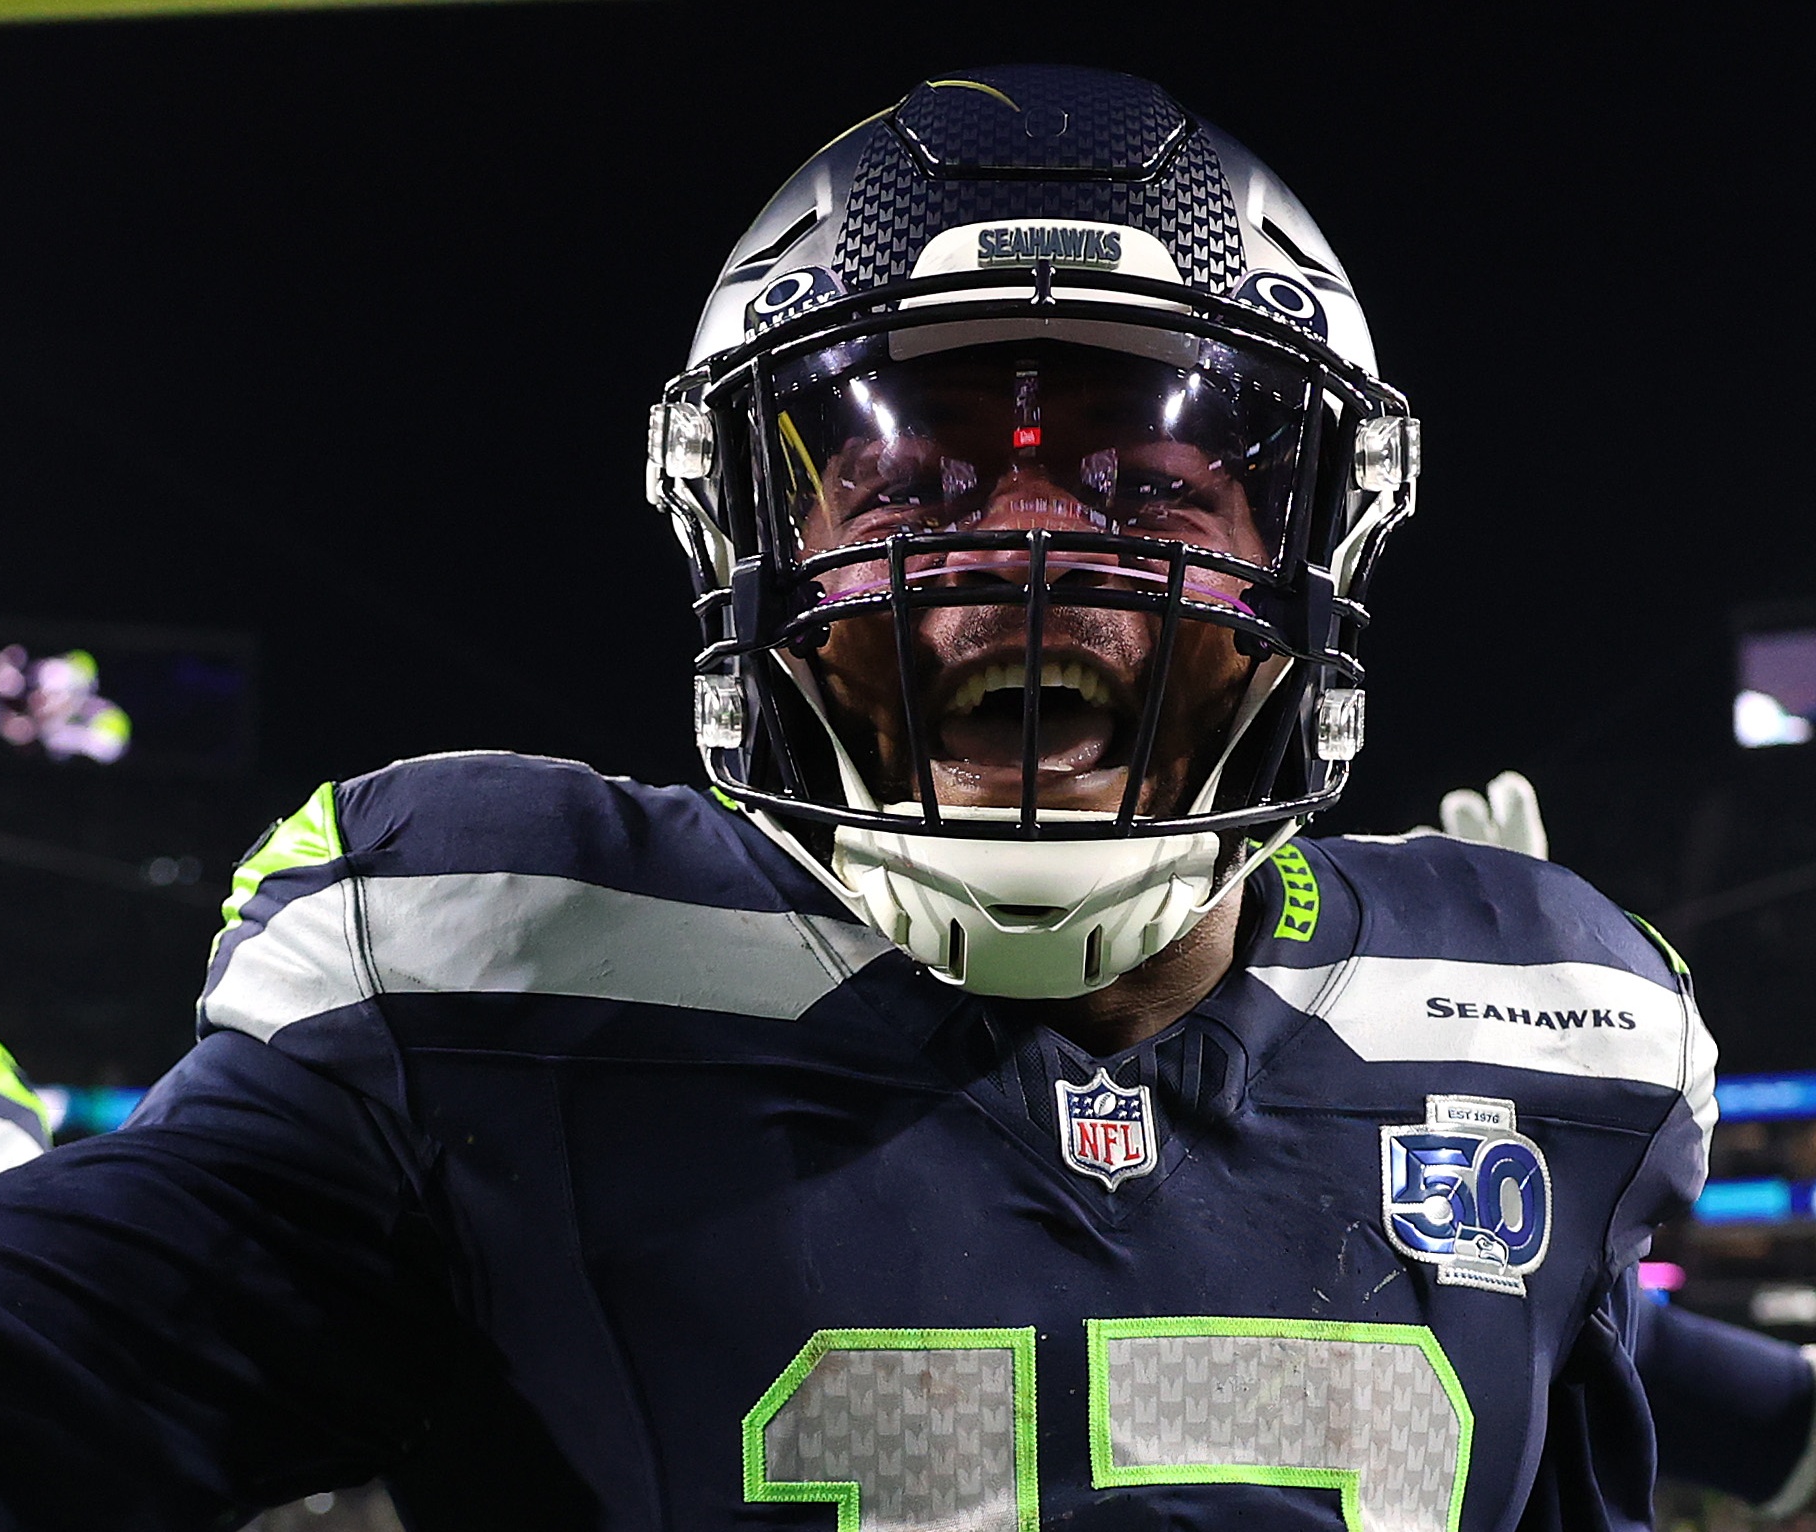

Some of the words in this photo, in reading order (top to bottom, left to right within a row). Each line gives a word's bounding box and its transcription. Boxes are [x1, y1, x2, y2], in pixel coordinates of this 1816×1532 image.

[978, 226, 1122, 262] SEAHAWKS
[1426, 997, 1636, 1030] SEAHAWKS
[1448, 1107, 1472, 1120] EST
[1474, 1110, 1500, 1124] 1976
[1077, 1121, 1141, 1166] NFL
[1390, 1136, 1546, 1266] 50
